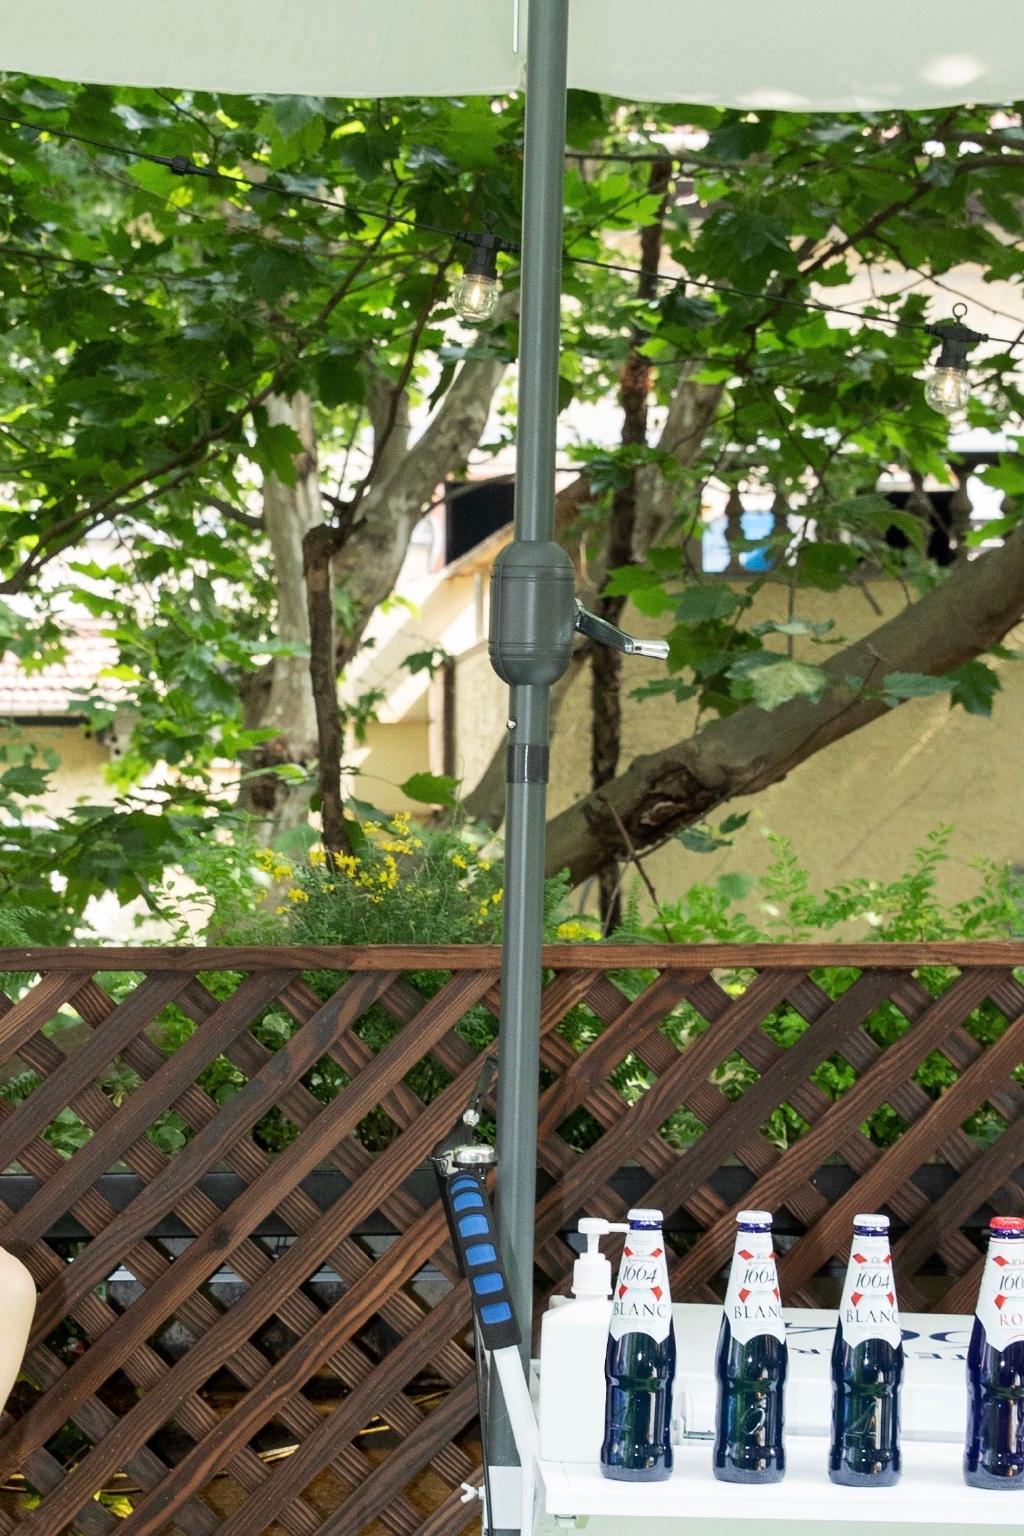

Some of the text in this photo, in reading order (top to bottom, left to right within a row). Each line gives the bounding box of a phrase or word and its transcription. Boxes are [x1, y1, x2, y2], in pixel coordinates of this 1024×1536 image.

[622, 1264, 658, 1283] 1664
[743, 1266, 775, 1285] 1664
[856, 1271, 890, 1289] 1664
[613, 1302, 668, 1319] BLANC
